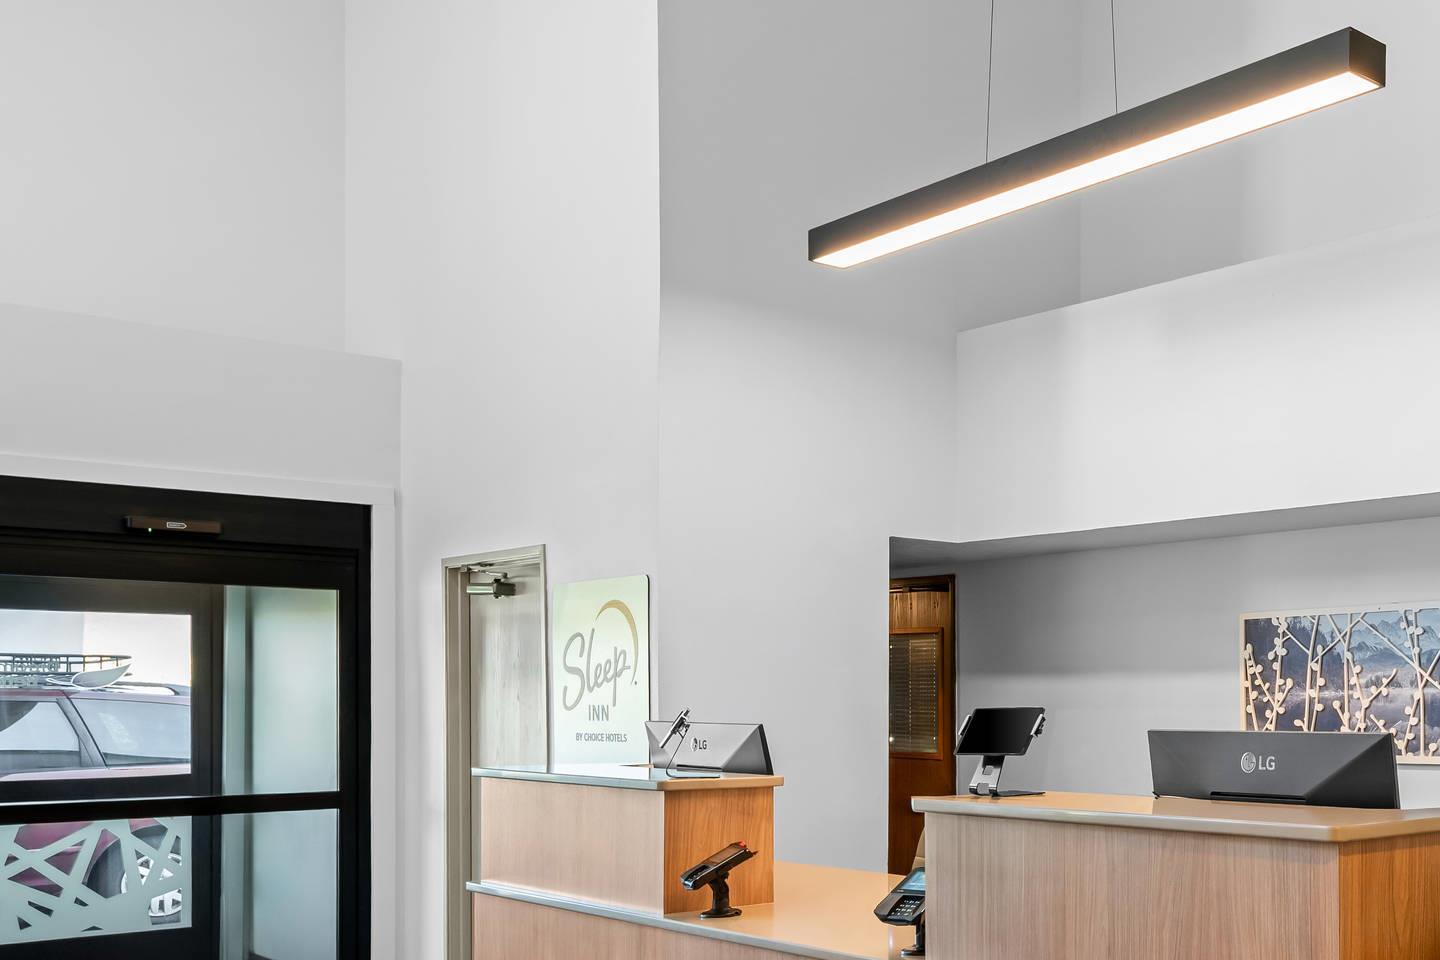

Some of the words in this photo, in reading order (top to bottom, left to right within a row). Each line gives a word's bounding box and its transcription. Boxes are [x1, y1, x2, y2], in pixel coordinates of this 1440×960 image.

[562, 628, 631, 711] Sleep
[588, 704, 609, 722] INN
[575, 732, 583, 742] BY
[584, 733, 605, 743] CHOICE
[605, 734, 628, 743] HOTELS
[1258, 755, 1276, 771] LG
